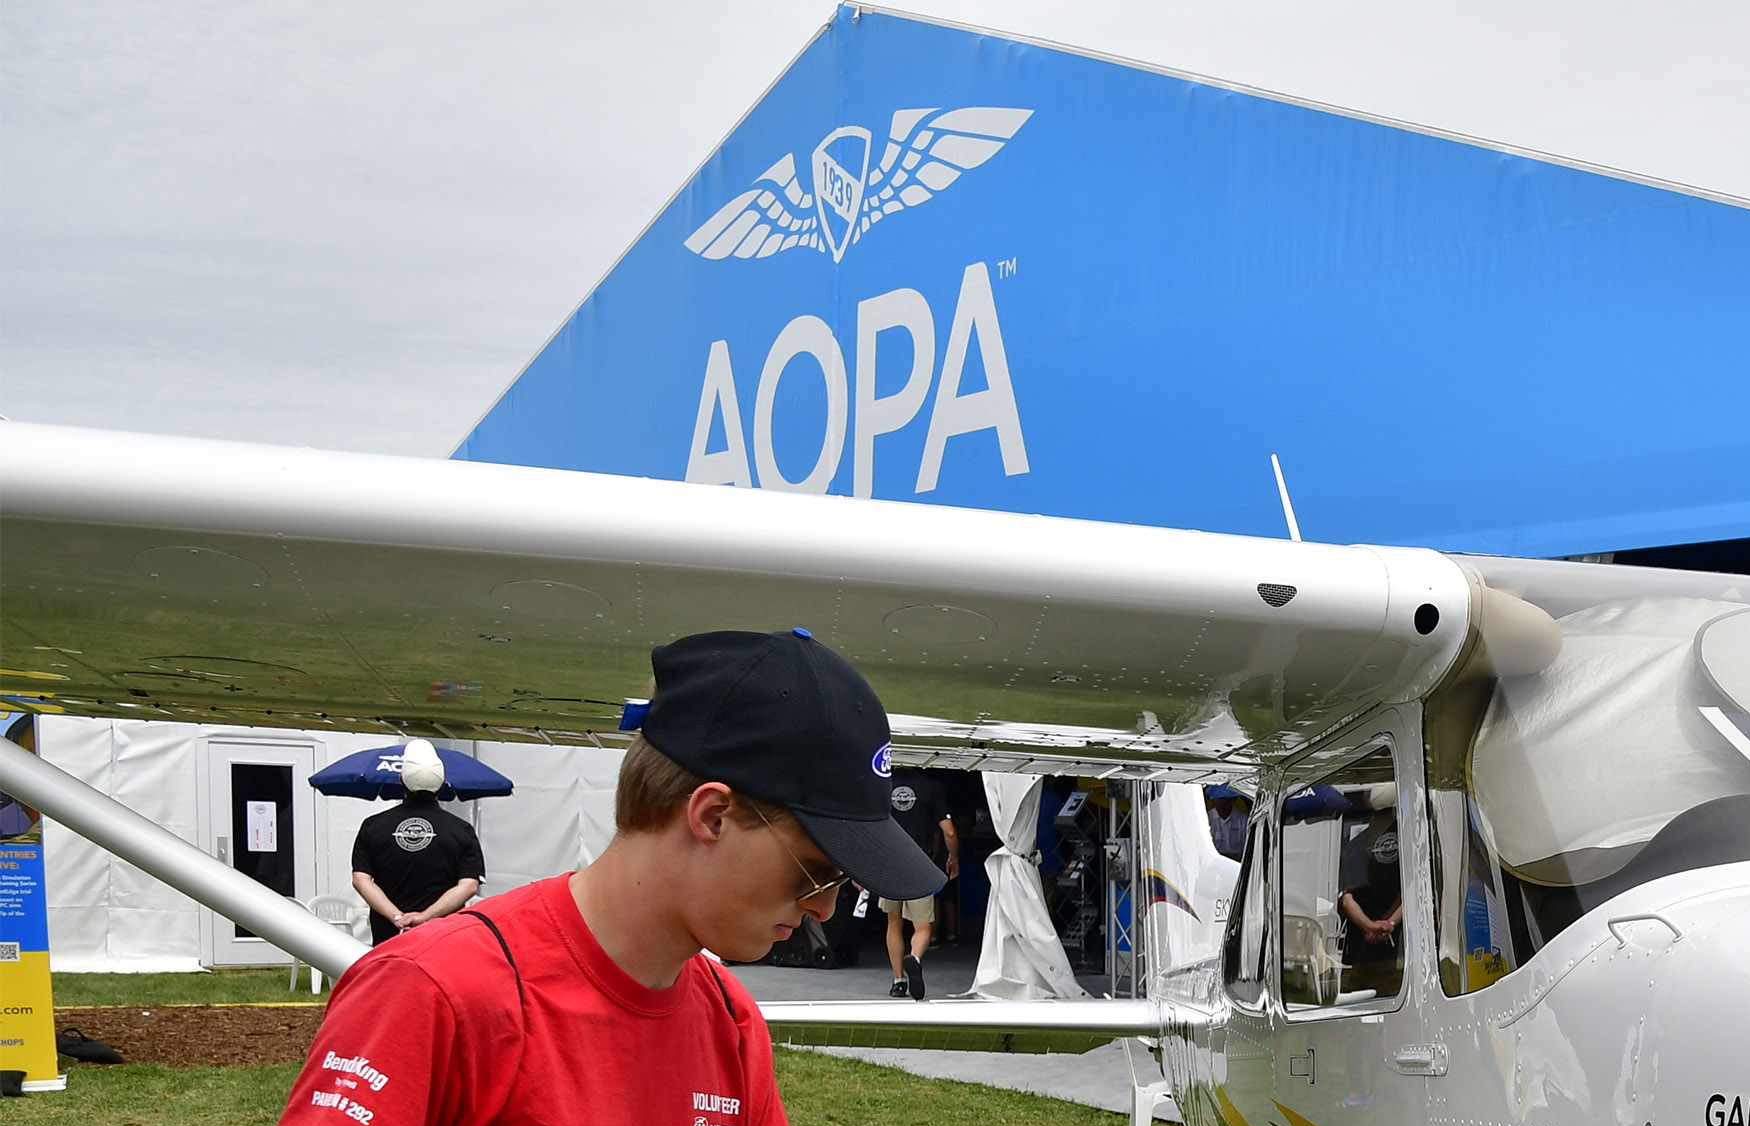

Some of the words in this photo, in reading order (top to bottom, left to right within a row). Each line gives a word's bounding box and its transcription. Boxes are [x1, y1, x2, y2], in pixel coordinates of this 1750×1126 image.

[823, 162, 852, 213] 1939
[685, 262, 1030, 498] AOPA
[322, 1051, 389, 1091] BendKing
[345, 1101, 374, 1126] 292
[693, 1092, 740, 1115] VOLUEER
